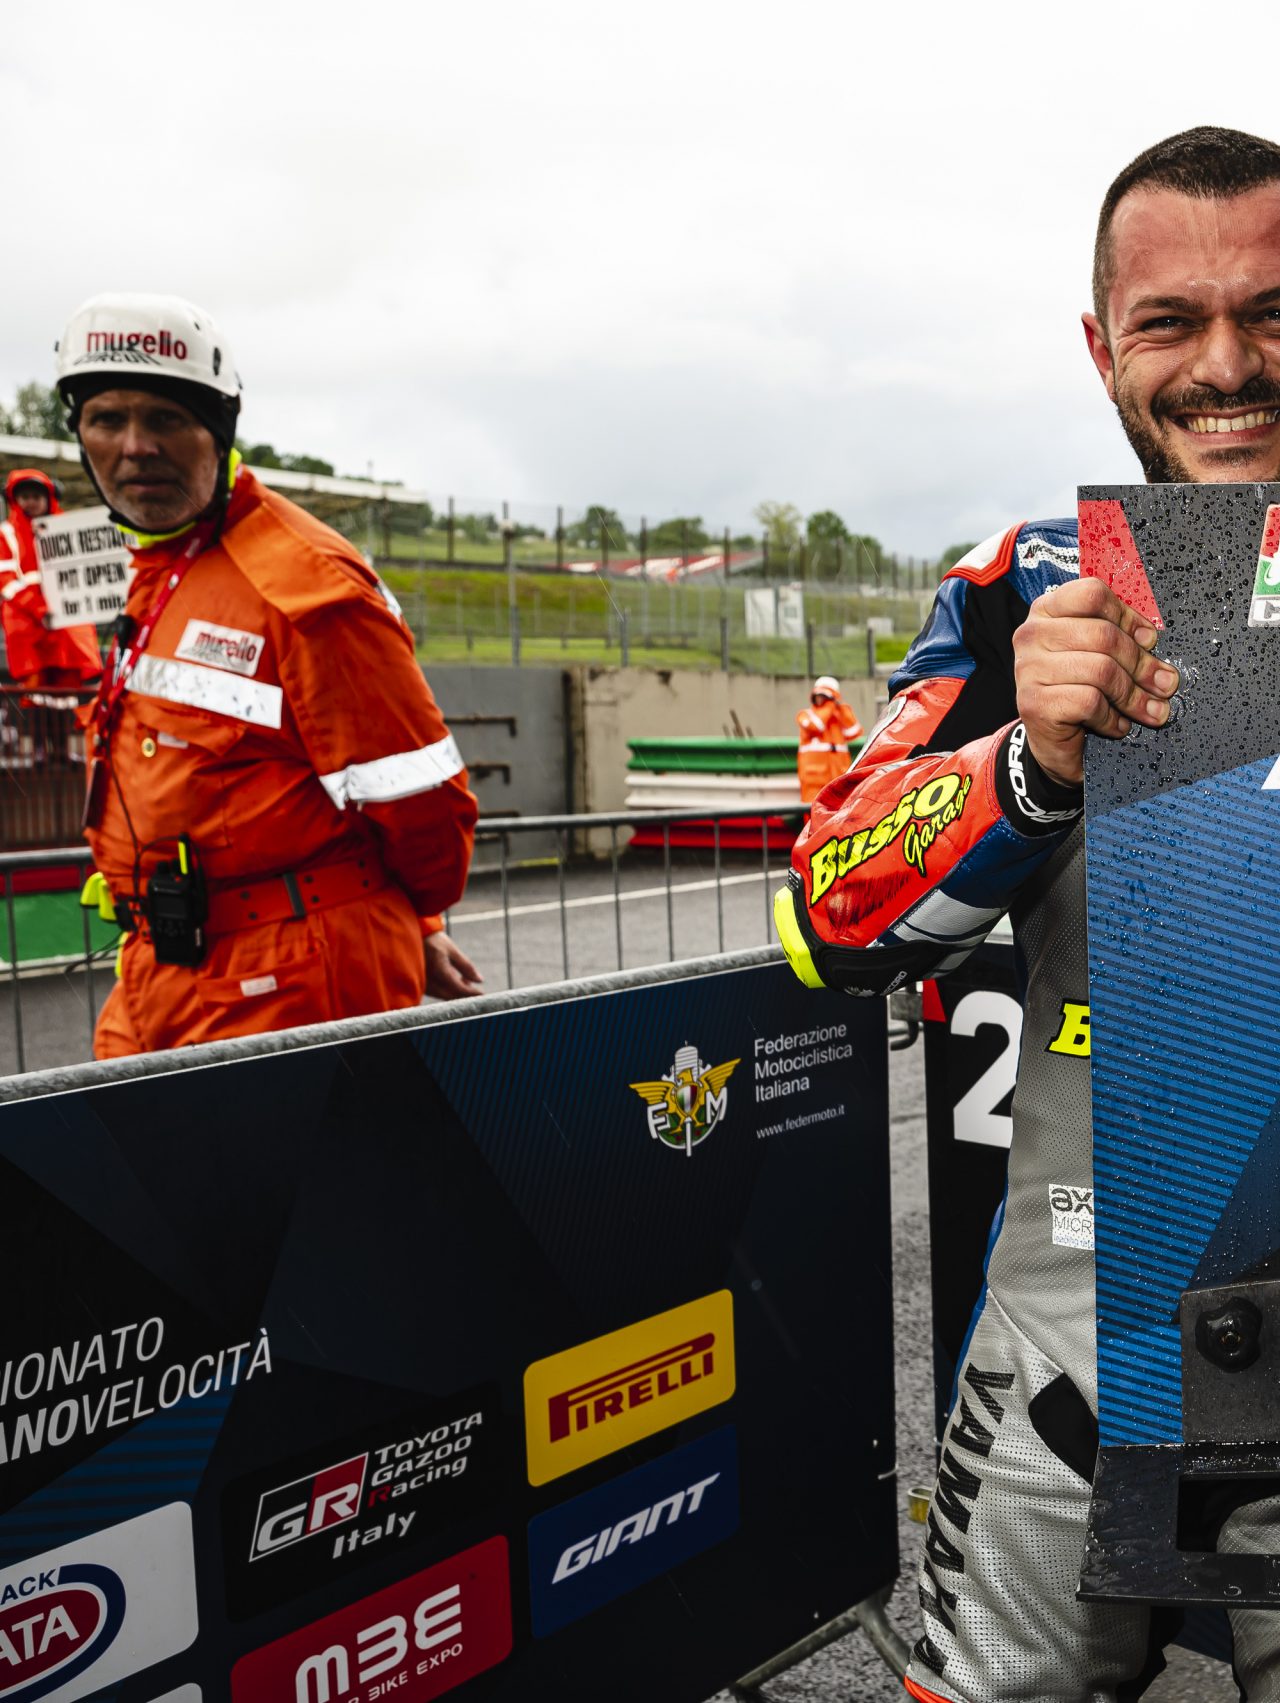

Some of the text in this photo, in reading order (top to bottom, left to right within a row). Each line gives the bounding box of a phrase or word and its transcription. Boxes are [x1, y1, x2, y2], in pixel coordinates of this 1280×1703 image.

[87, 329, 188, 360] mugello
[85, 562, 125, 587] OPEN
[903, 773, 974, 878] Garage
[754, 1024, 848, 1058] Federazione
[754, 1043, 853, 1080] Motociclistica
[755, 1076, 811, 1103] Italiana
[950, 989, 1024, 1149] 2
[756, 1103, 846, 1140] www.federmoto.it
[548, 1331, 716, 1444] PIRELLI
[371, 1435, 472, 1487] GAZOO
[374, 1411, 483, 1466] TOYOTA
[367, 1456, 468, 1509] Racing
[256, 1482, 360, 1552] GR
[332, 1510, 416, 1560] Italy
[551, 1472, 721, 1585] GIANT
[368, 1642, 464, 1702] BIKE EXPO
